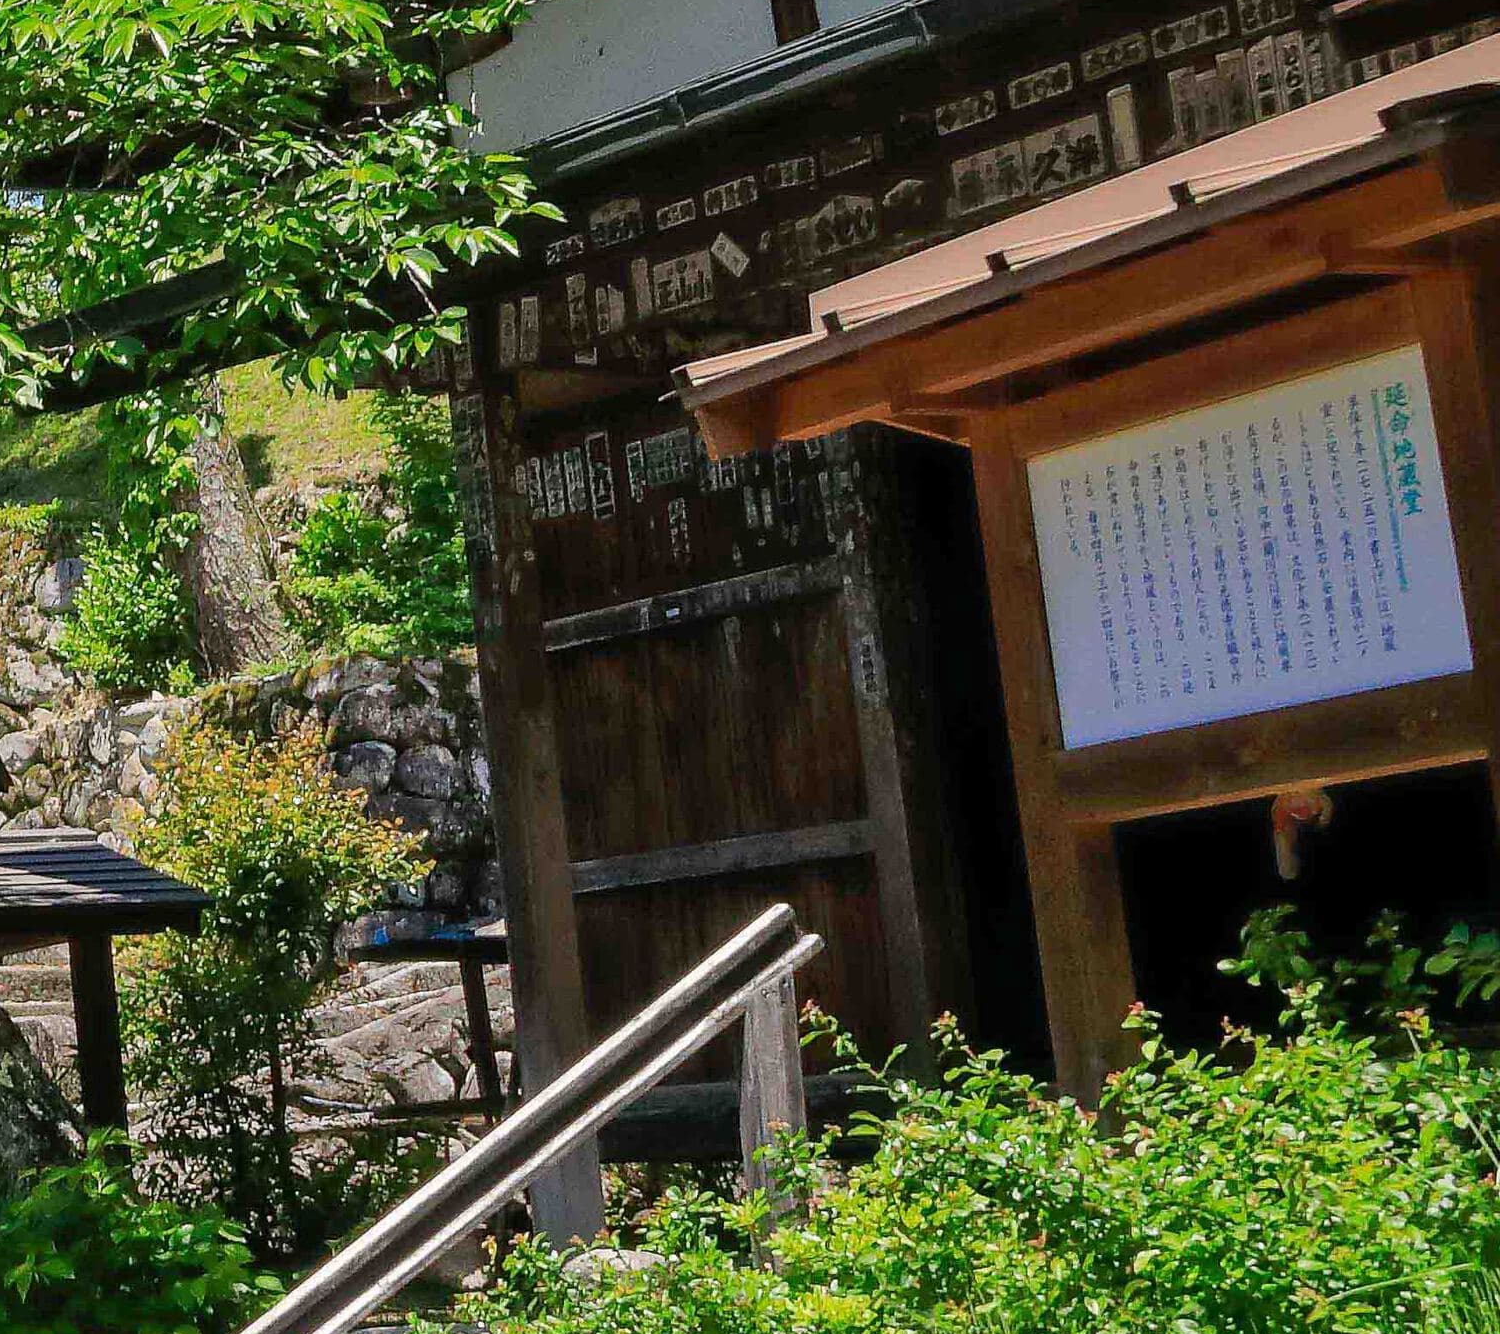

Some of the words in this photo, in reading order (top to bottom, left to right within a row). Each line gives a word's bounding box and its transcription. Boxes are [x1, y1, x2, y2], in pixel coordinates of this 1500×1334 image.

[1381, 380, 1426, 518] 延命地蔵堂
